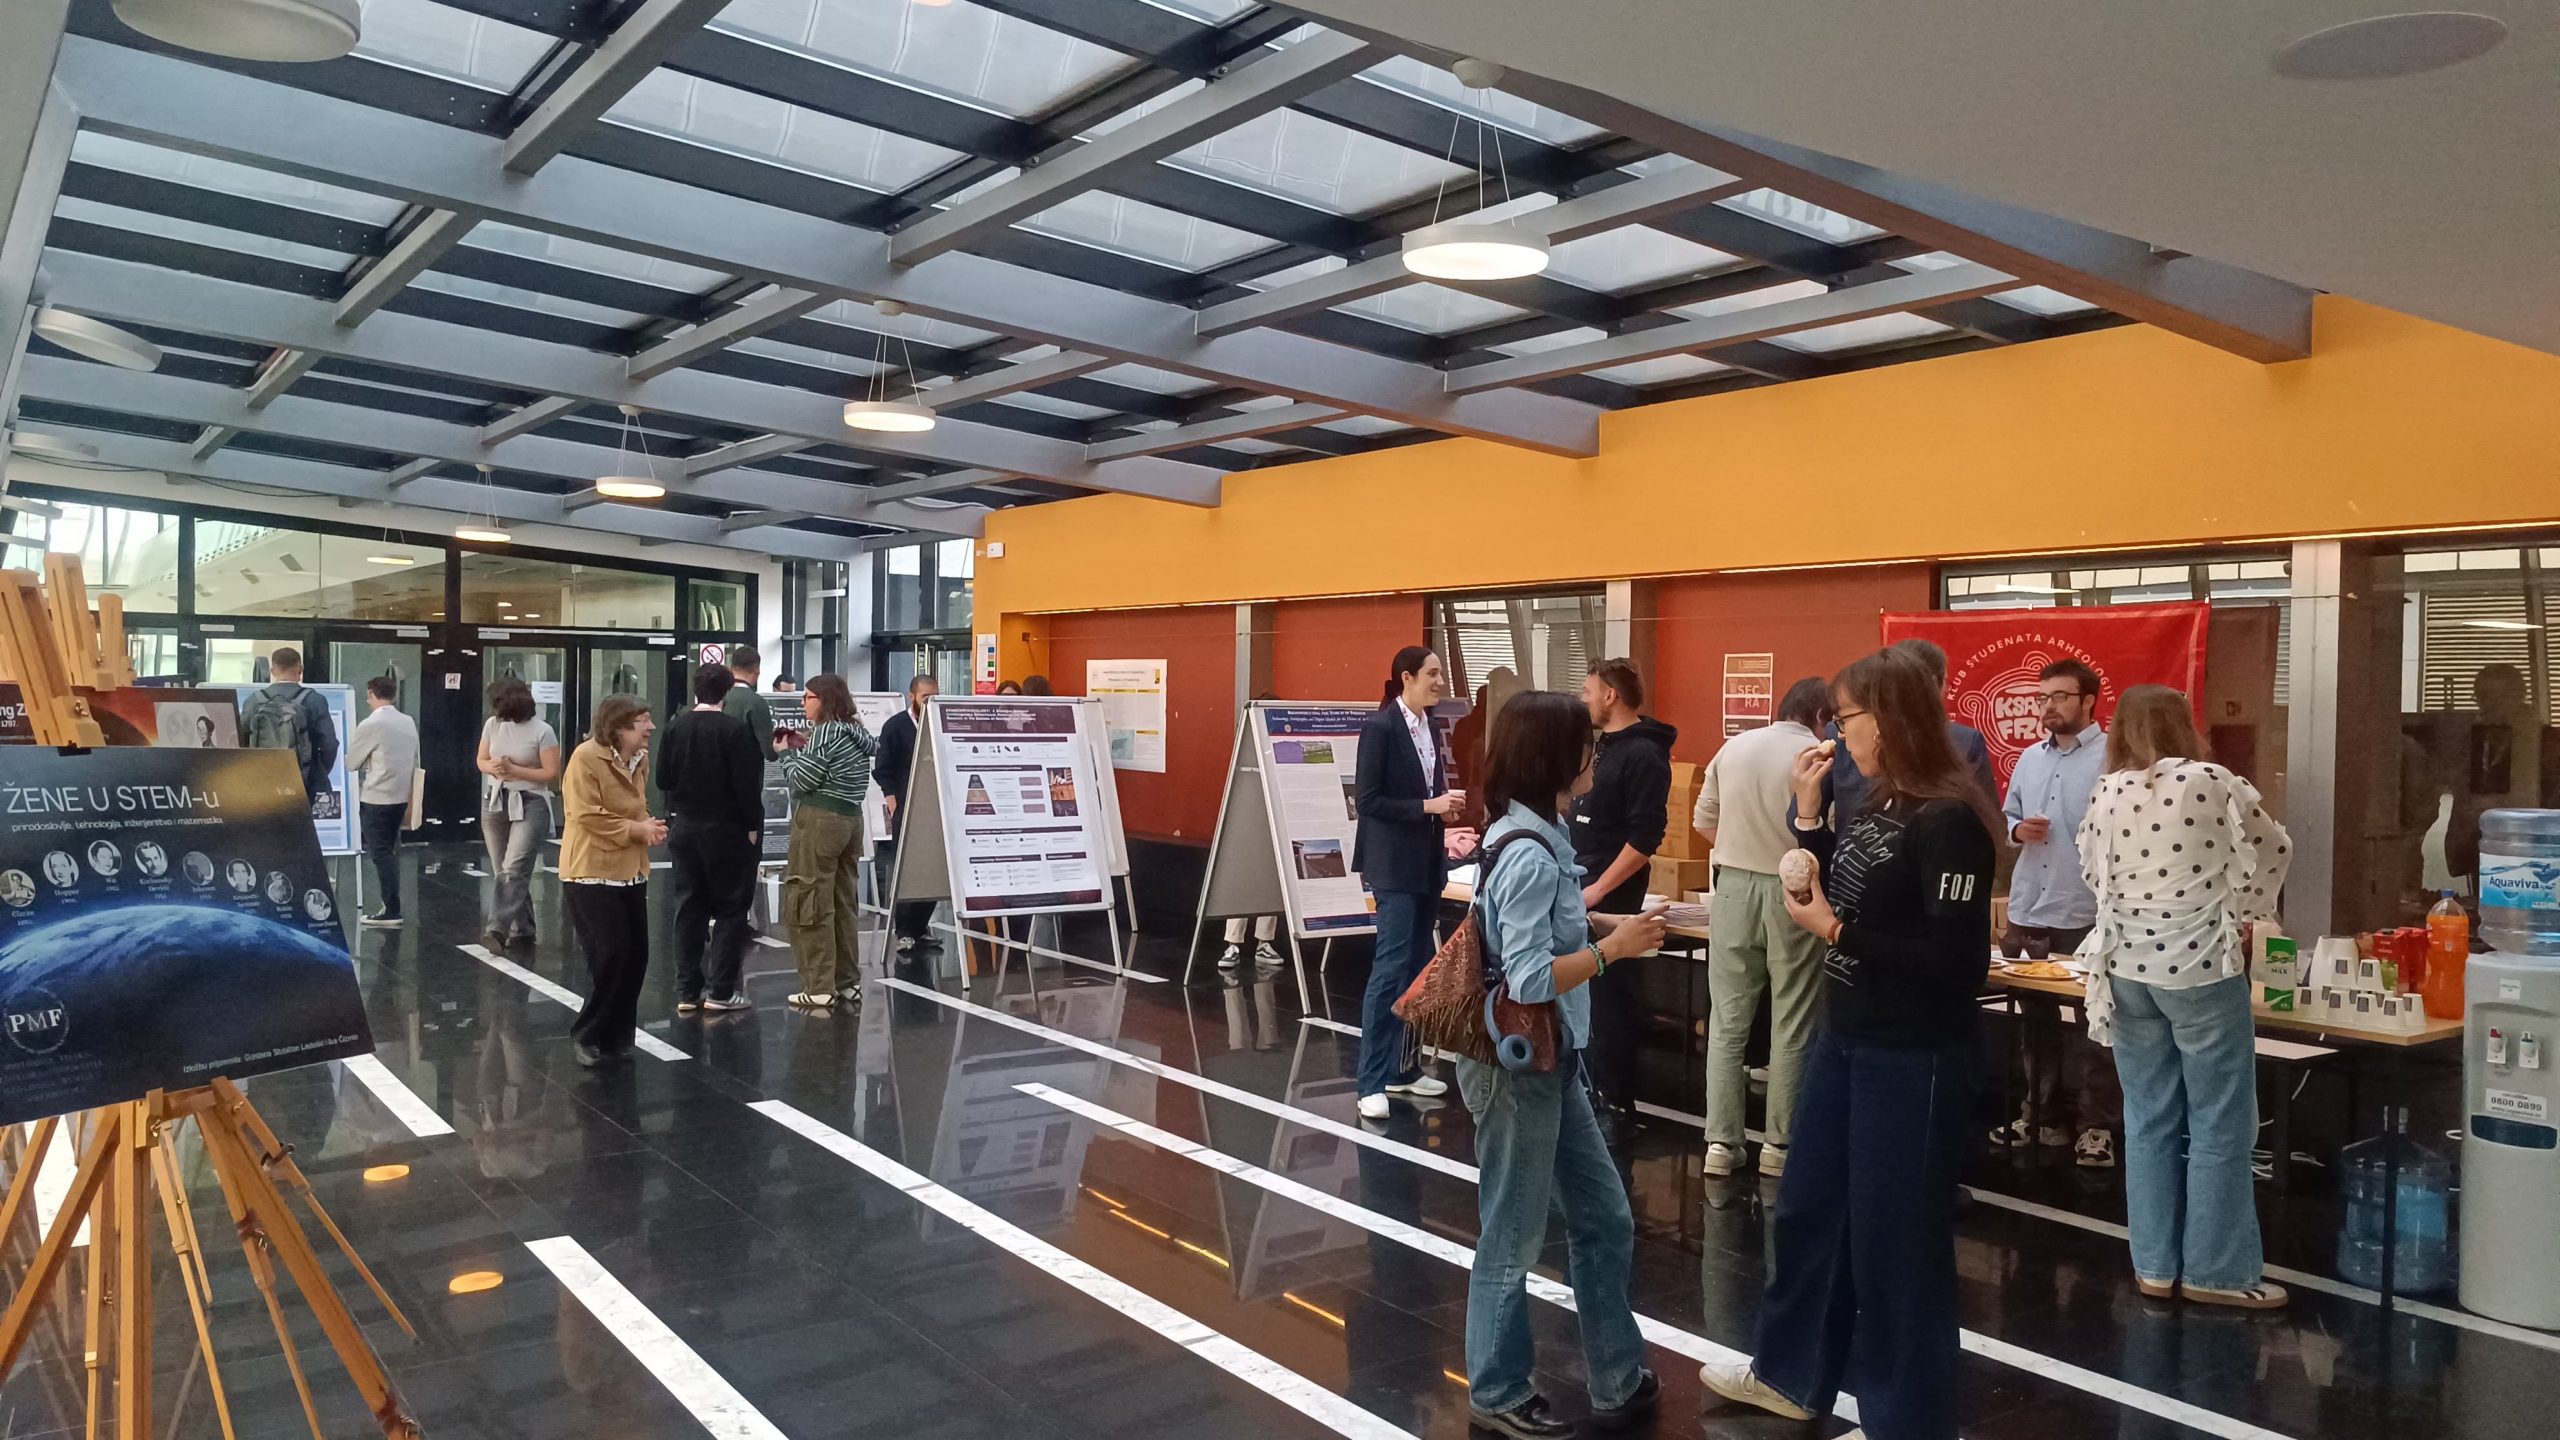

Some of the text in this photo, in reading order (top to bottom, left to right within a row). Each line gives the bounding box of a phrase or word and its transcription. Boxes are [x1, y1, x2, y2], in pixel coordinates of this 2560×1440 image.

[1946, 633, 2116, 703] KLUB STUDENATA ARHEOLOGIJE
[3, 781, 220, 813] ŽENE U STEM-u
[1938, 872, 1976, 902] FOB
[2489, 875, 2539, 889] Aquaviva
[8, 1008, 62, 1033] PMF
[2491, 1096, 2515, 1107] 0800
[2517, 1101, 2543, 1112] 0899
